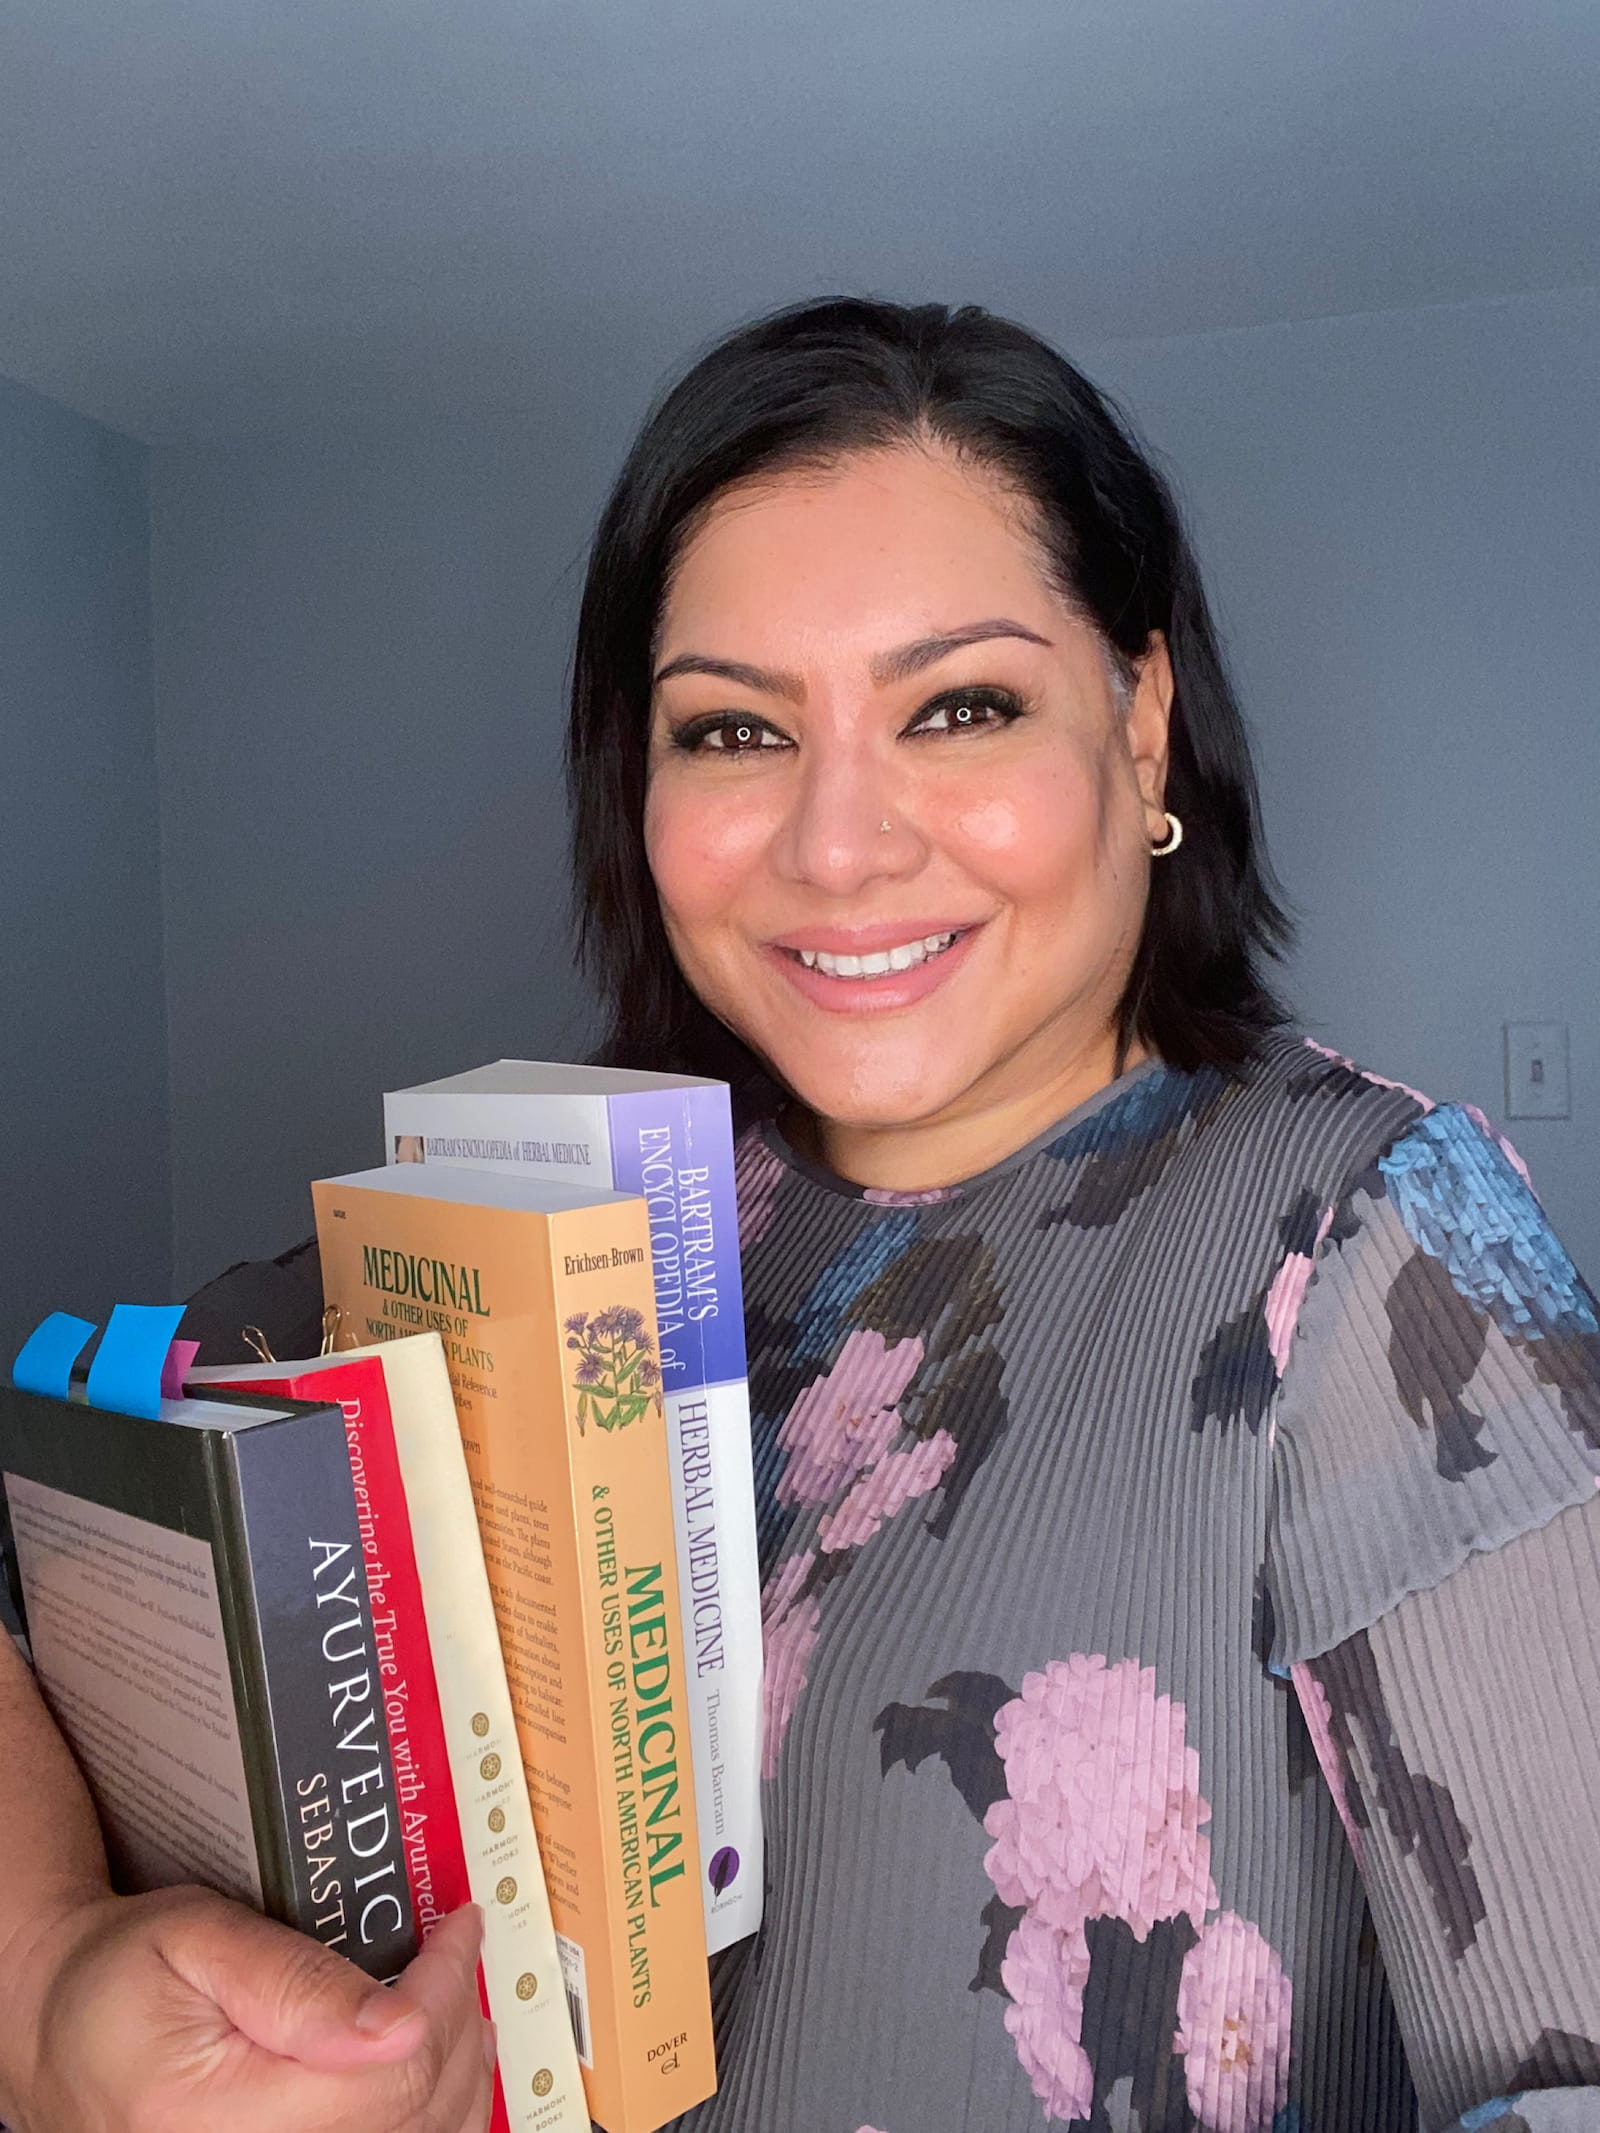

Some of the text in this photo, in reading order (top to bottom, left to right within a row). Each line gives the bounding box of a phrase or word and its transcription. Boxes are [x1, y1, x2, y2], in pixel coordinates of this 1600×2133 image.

[426, 1138, 462, 1158] BARTRAM'S
[462, 1138, 512, 1160] ENCYCLOPEDIA
[523, 1141, 550, 1163] HERBAL
[552, 1144, 592, 1165] MEDICINE
[564, 1246, 645, 1276] Erichsen-Brown
[638, 1125, 686, 1372] ENCYCLOPEDIA of
[677, 1165, 719, 1322] BARTRAM'S
[362, 1245, 491, 1317] MEDICINAL
[365, 1317, 397, 1338] NORTH
[382, 1299, 389, 1316] &
[391, 1302, 424, 1326] OTHER
[425, 1309, 452, 1332] USES
[454, 1317, 468, 1338] OF
[451, 1342, 495, 1373] PLANTS
[336, 1397, 379, 1555] Discovering
[364, 1561, 392, 1606] the
[372, 1609, 398, 1677] True
[678, 1399, 726, 1836] HERBAL MEDICINE Thomas Bartram
[308, 1536, 403, 1945] AYURVEDIC
[383, 1680, 409, 1735] You
[624, 1561, 686, 1908] MEDICINAL
[393, 1738, 426, 1805] with
[591, 1484, 652, 2009] & OTHER USES OF NORTH AMERICAN PLANTS
[296, 1772, 350, 1950] SEBASTI
[647, 2031, 688, 2062] DOVER
[525, 2094, 567, 2121] HARMONY
[535, 2111, 564, 2133] BOOKS
